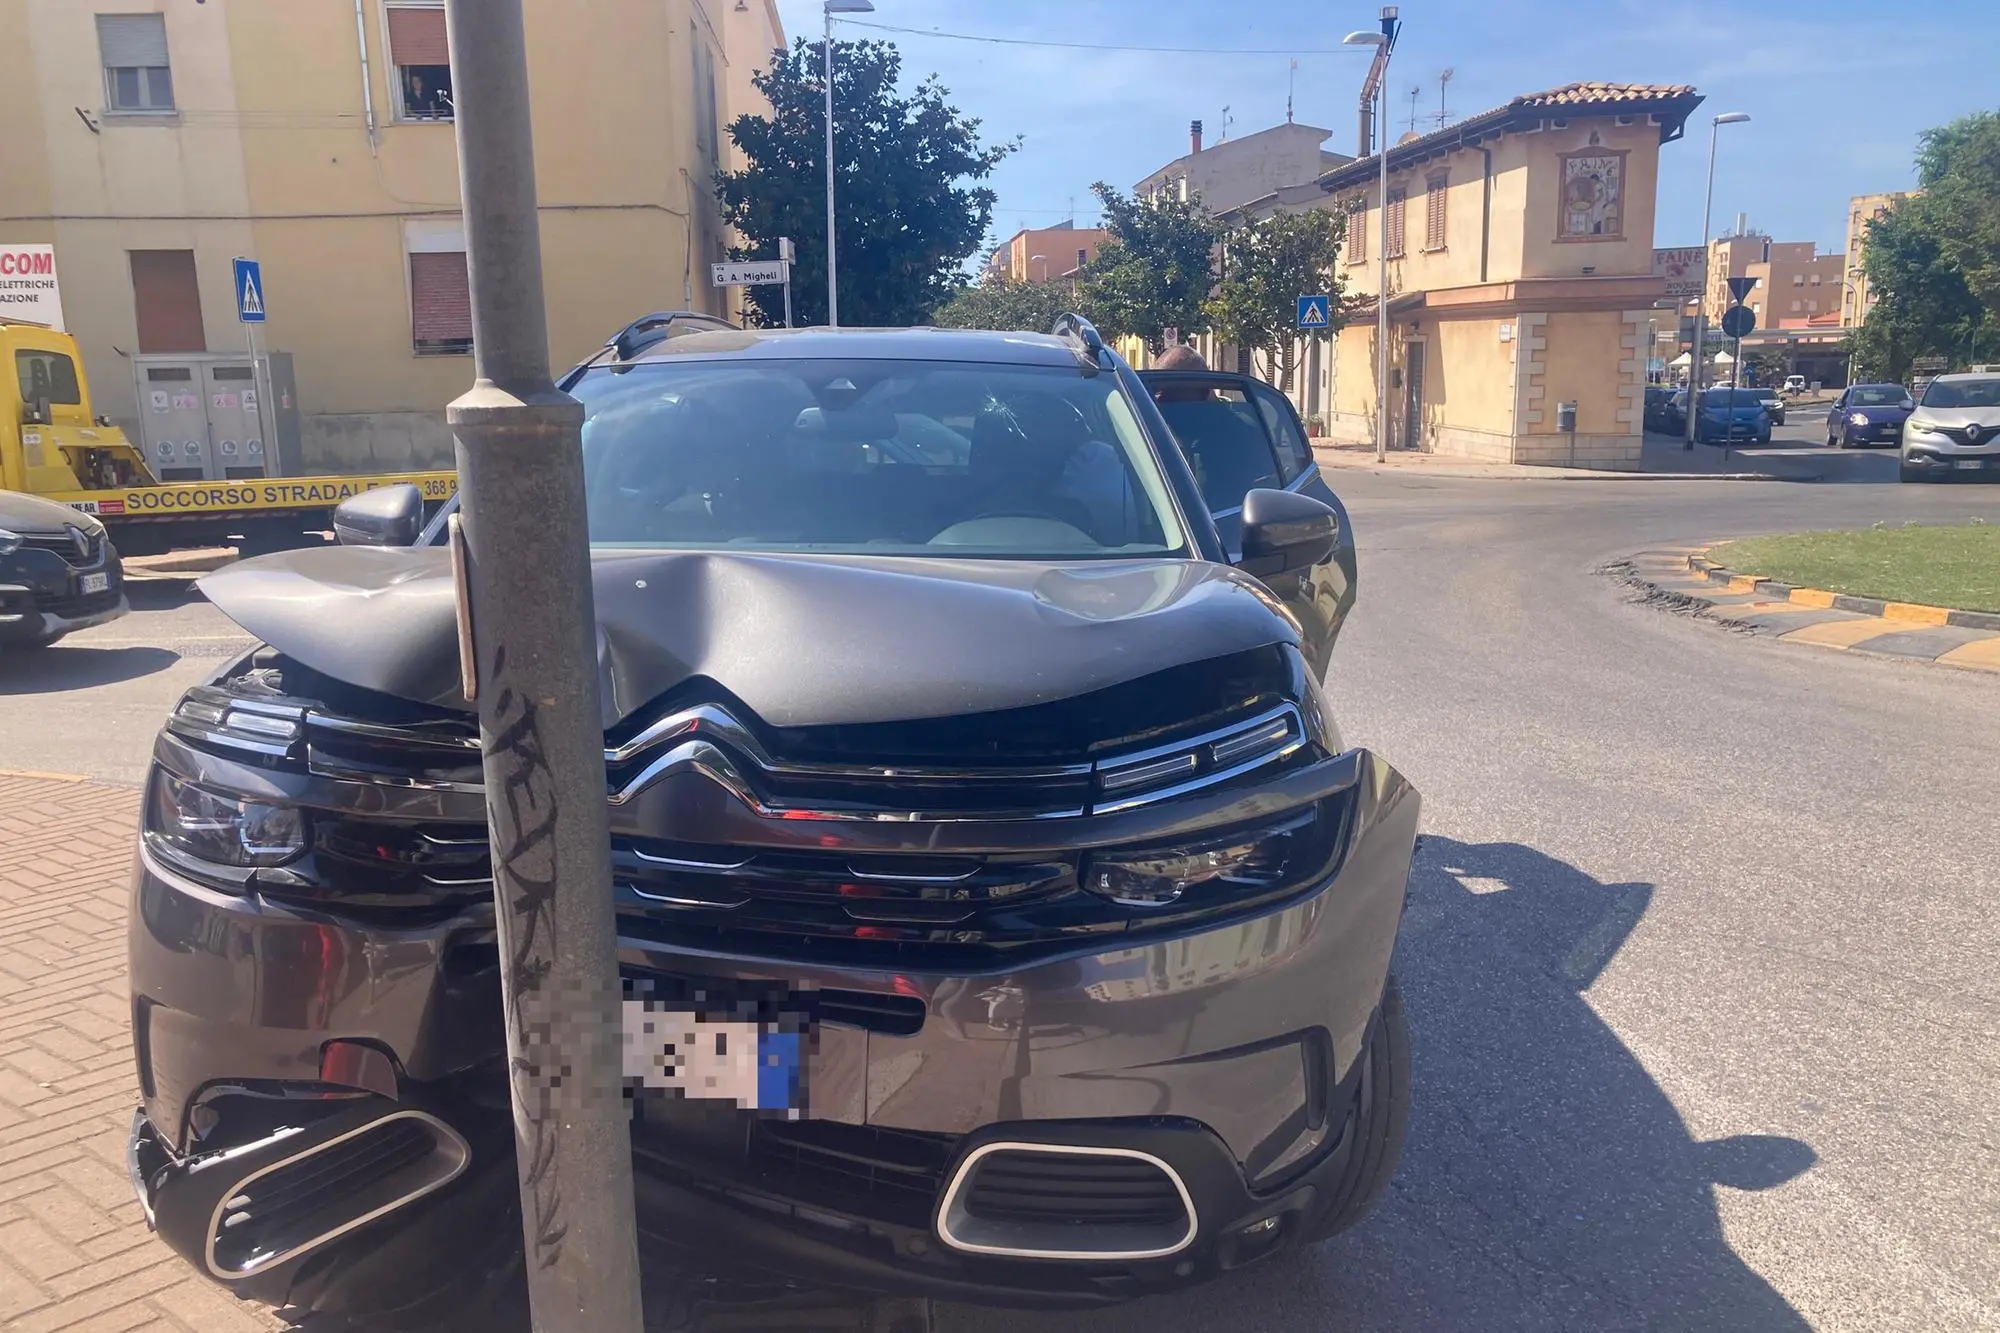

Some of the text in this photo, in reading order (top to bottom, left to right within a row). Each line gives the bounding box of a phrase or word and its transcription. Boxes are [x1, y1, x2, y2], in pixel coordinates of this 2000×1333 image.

[1, 253, 52, 275] COM
[744, 272, 777, 281] Migheli
[127, 487, 257, 509] SOCCORSO
[425, 480, 446, 496] 368
